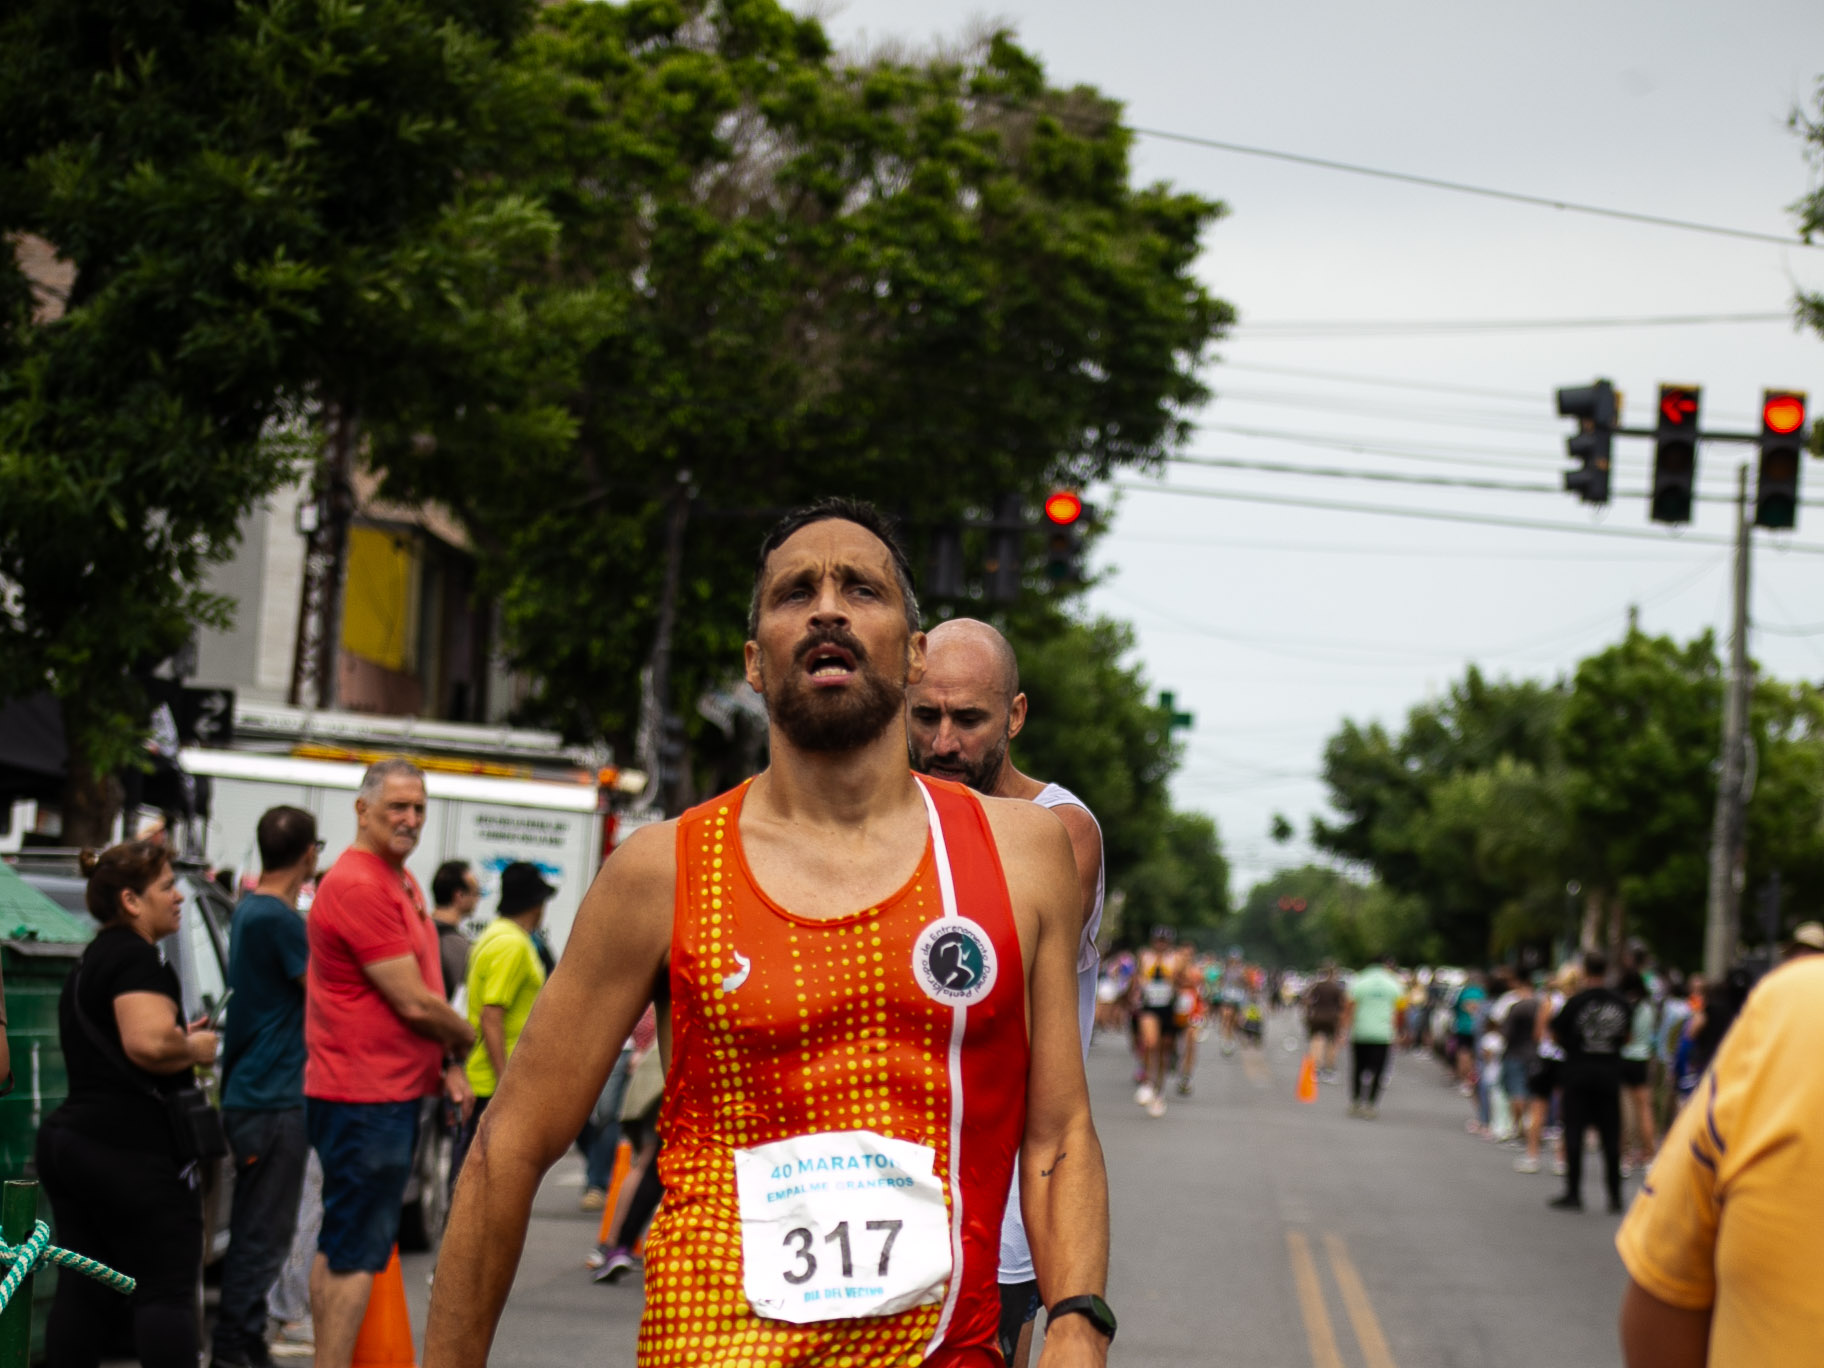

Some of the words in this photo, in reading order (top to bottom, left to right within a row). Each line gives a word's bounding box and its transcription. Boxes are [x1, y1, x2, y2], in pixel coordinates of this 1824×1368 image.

[921, 943, 931, 956] de
[771, 1163, 793, 1179] 40
[783, 1220, 903, 1285] 317
